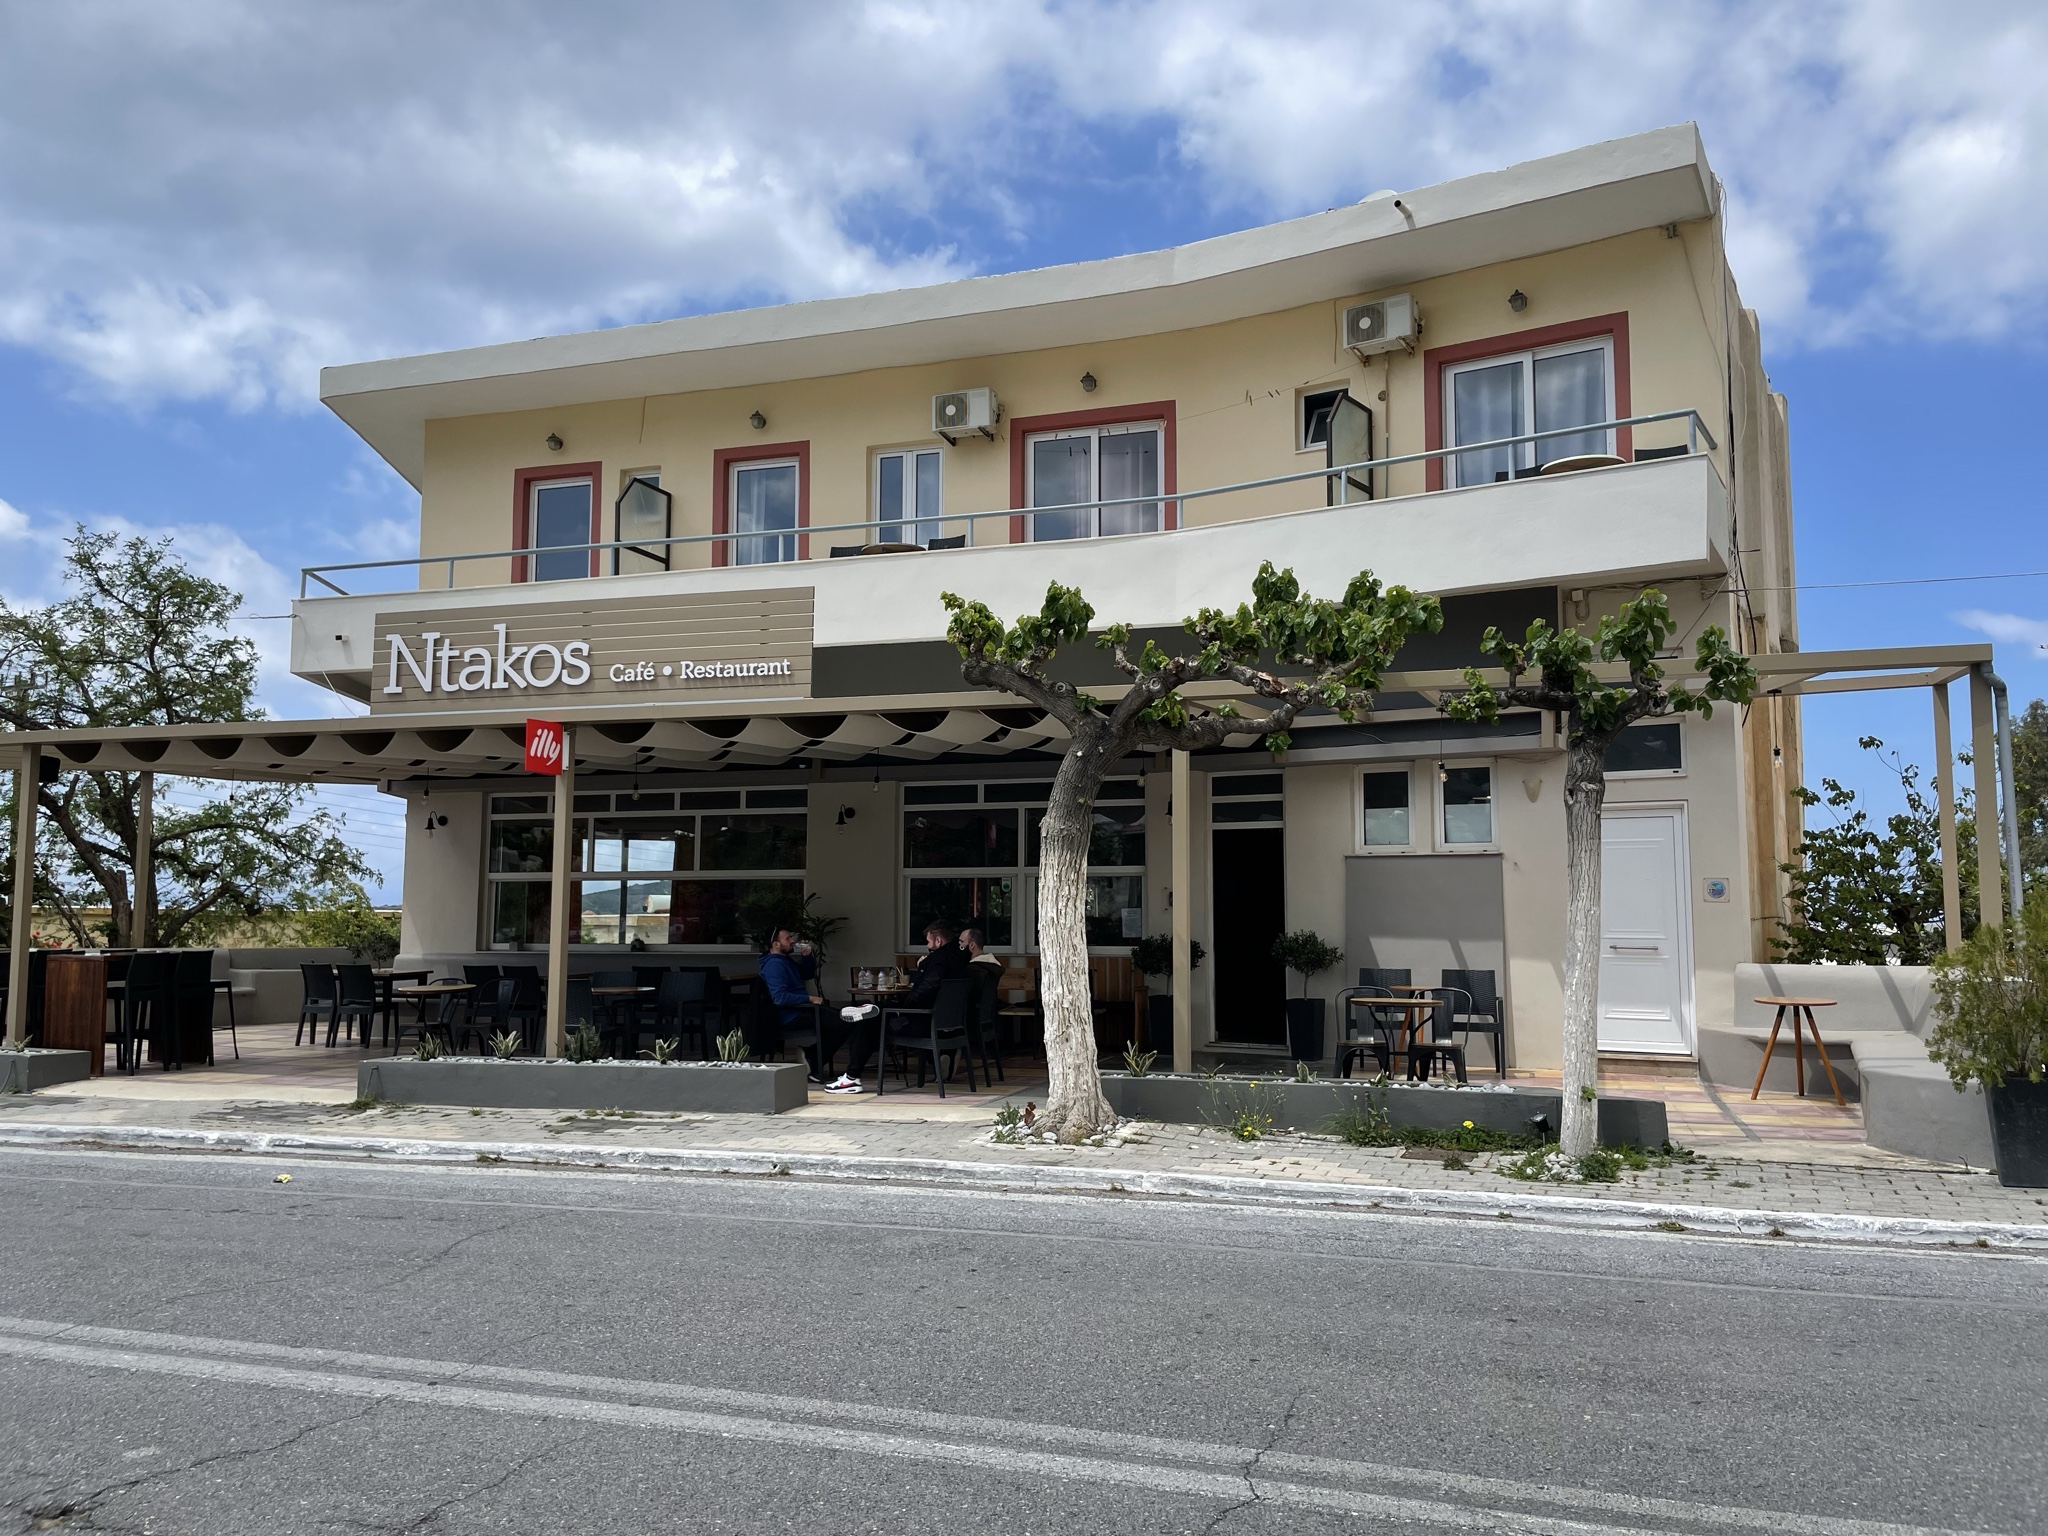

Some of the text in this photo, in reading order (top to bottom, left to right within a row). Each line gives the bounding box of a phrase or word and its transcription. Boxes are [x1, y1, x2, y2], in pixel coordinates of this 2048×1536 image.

[383, 623, 791, 694] Ntakos Café Restaurant
[530, 728, 561, 766] illy
